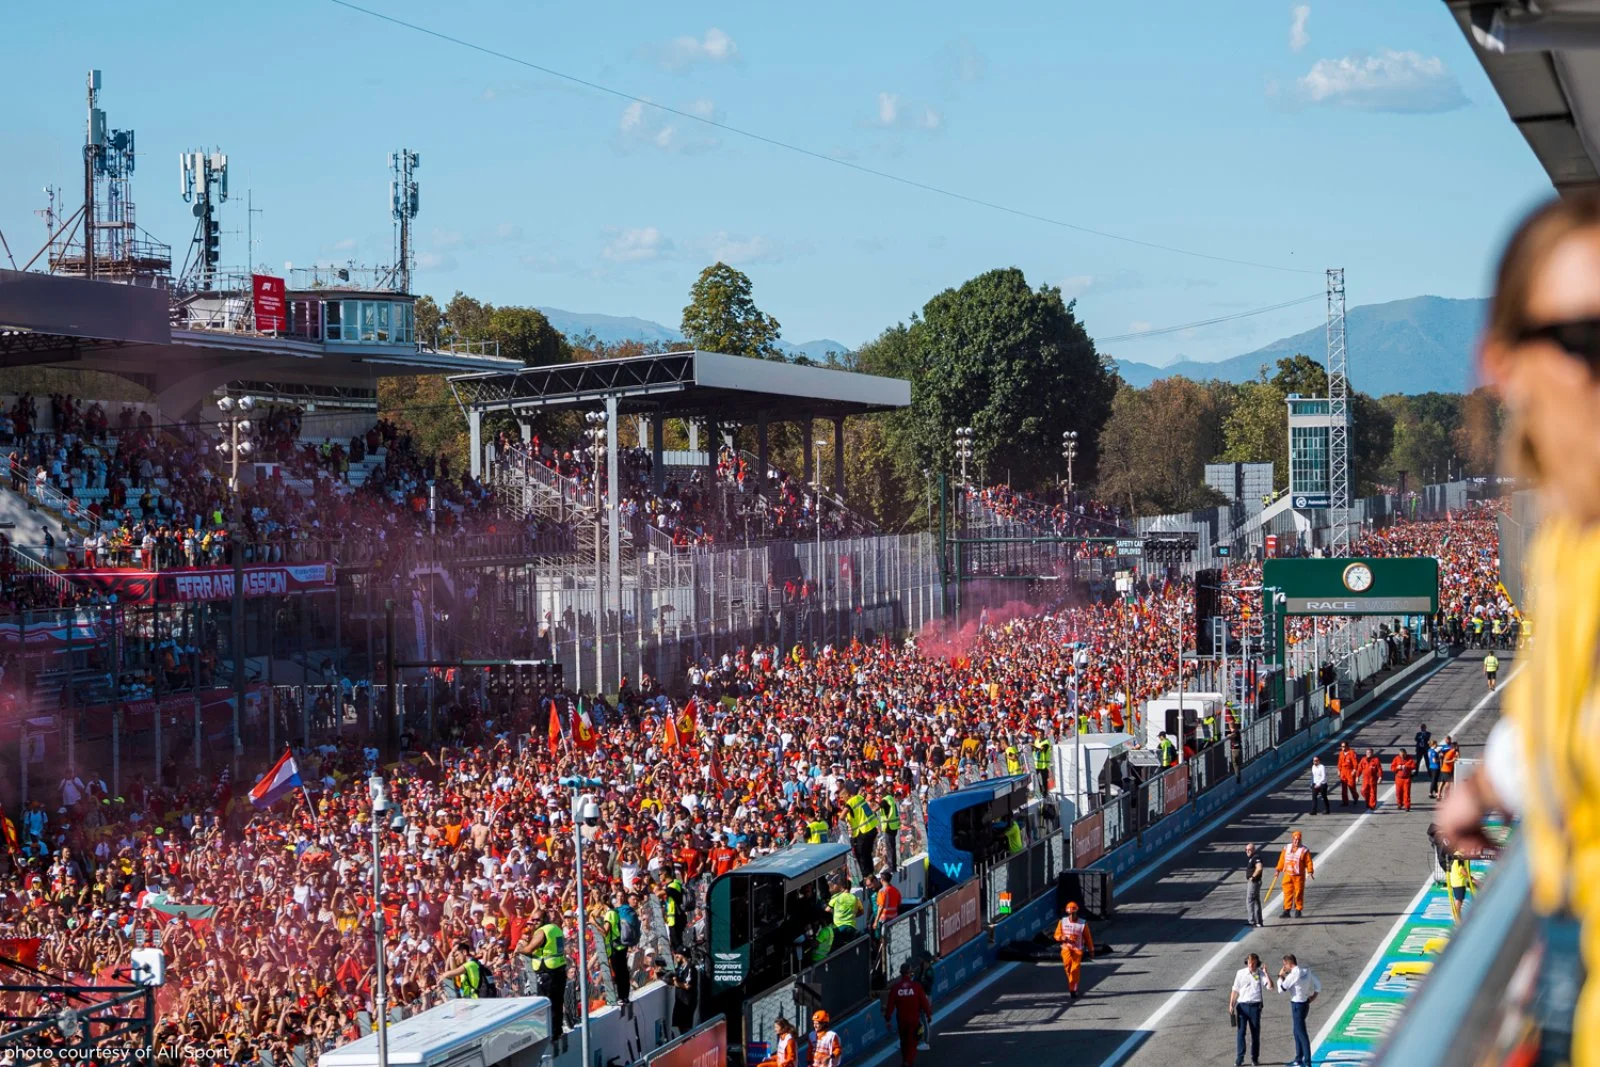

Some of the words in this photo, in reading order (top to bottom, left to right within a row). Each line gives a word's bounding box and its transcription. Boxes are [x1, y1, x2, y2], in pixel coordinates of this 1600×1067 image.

[1306, 601, 1356, 610] RACE
[943, 862, 963, 878] W
[714, 974, 742, 982] aramco
